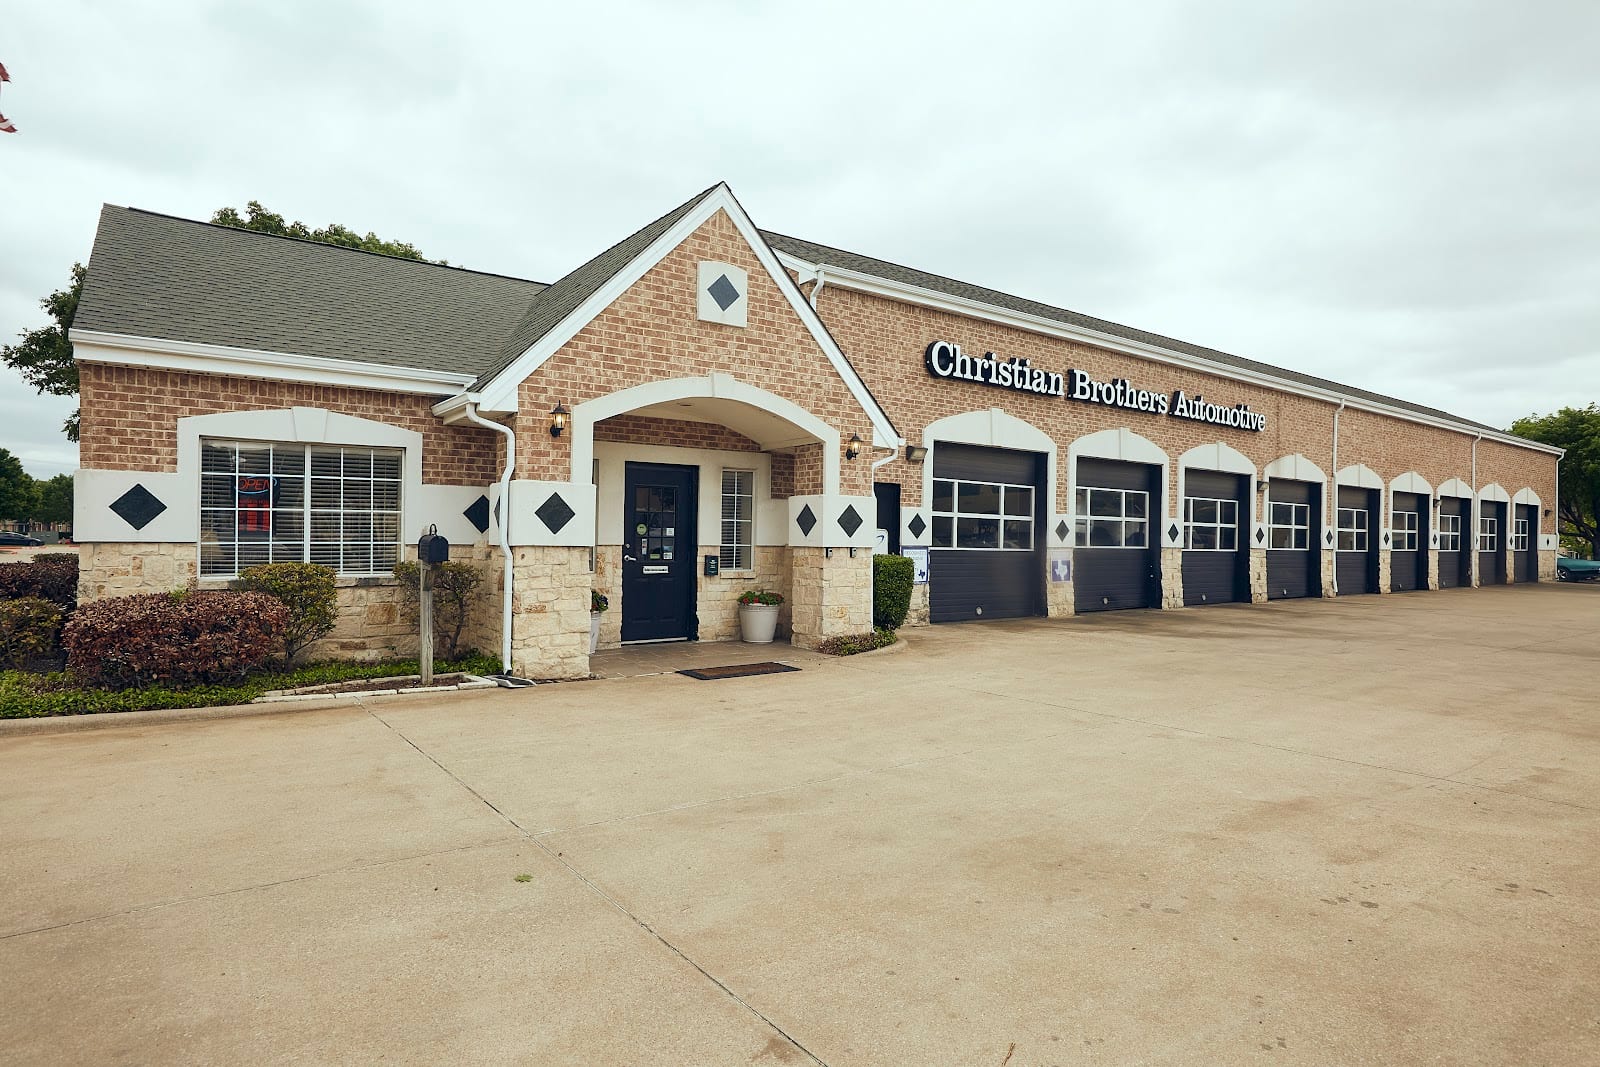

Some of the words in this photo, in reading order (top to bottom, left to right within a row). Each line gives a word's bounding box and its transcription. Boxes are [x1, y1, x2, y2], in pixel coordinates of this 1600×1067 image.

[930, 340, 1064, 396] Christian
[1073, 368, 1168, 414] Brothers
[1175, 390, 1266, 432] Automotive
[238, 478, 270, 490] OPEN
